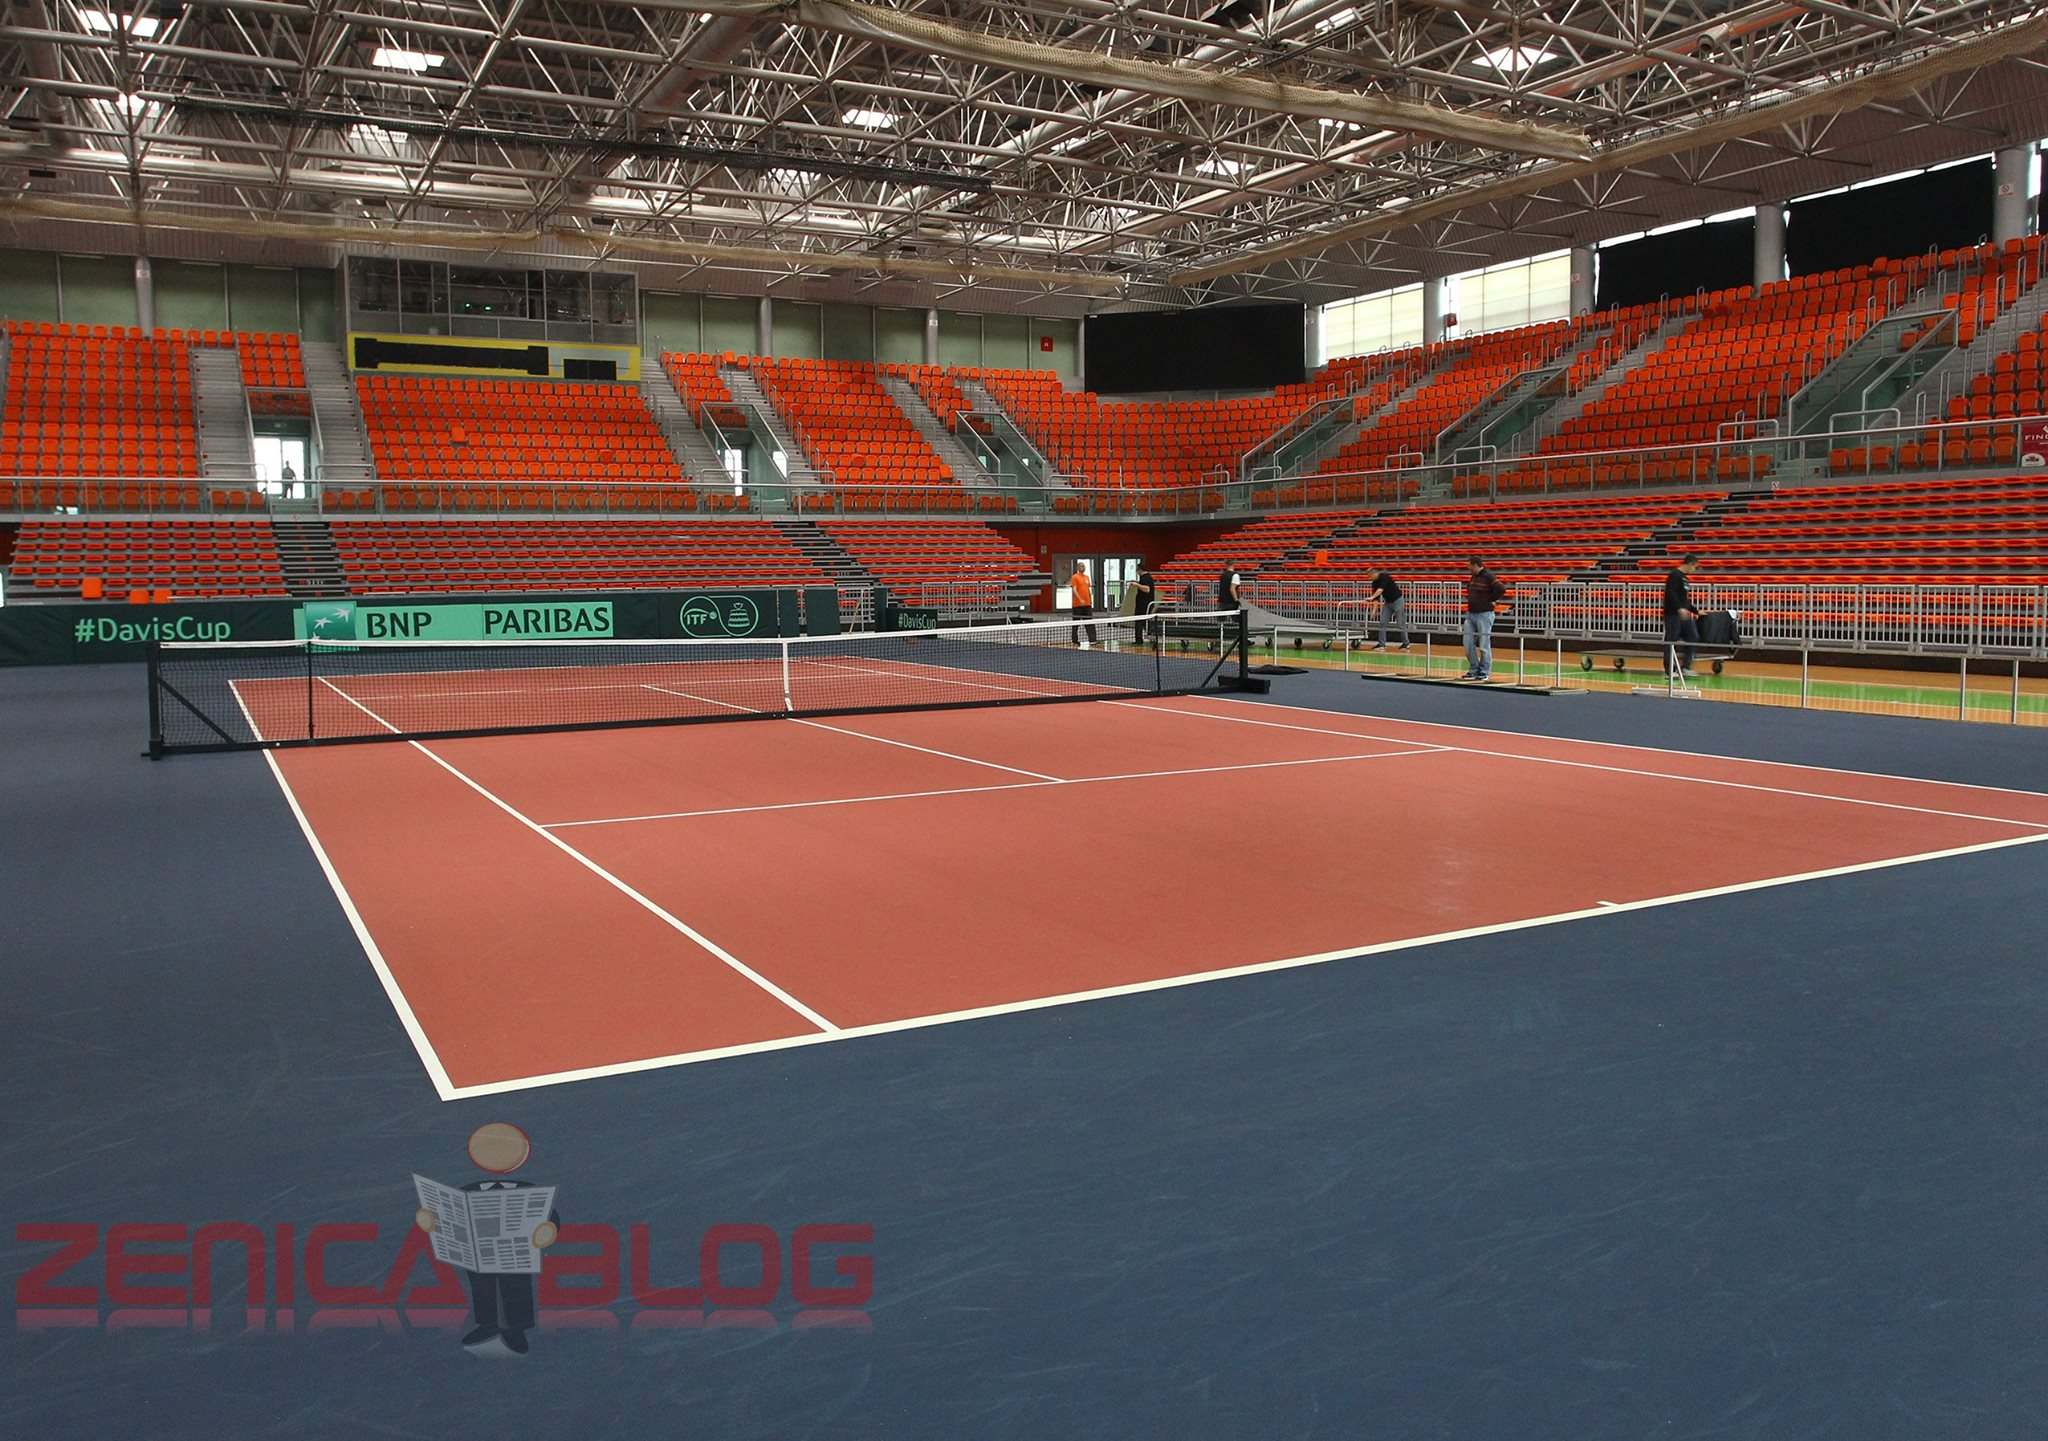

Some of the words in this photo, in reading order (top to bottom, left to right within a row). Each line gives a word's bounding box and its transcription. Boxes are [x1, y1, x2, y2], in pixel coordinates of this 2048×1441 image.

[74, 616, 231, 642] #DavisCup
[366, 611, 433, 639] BNP
[484, 607, 610, 635] PARIBAS
[687, 614, 707, 625] ITF
